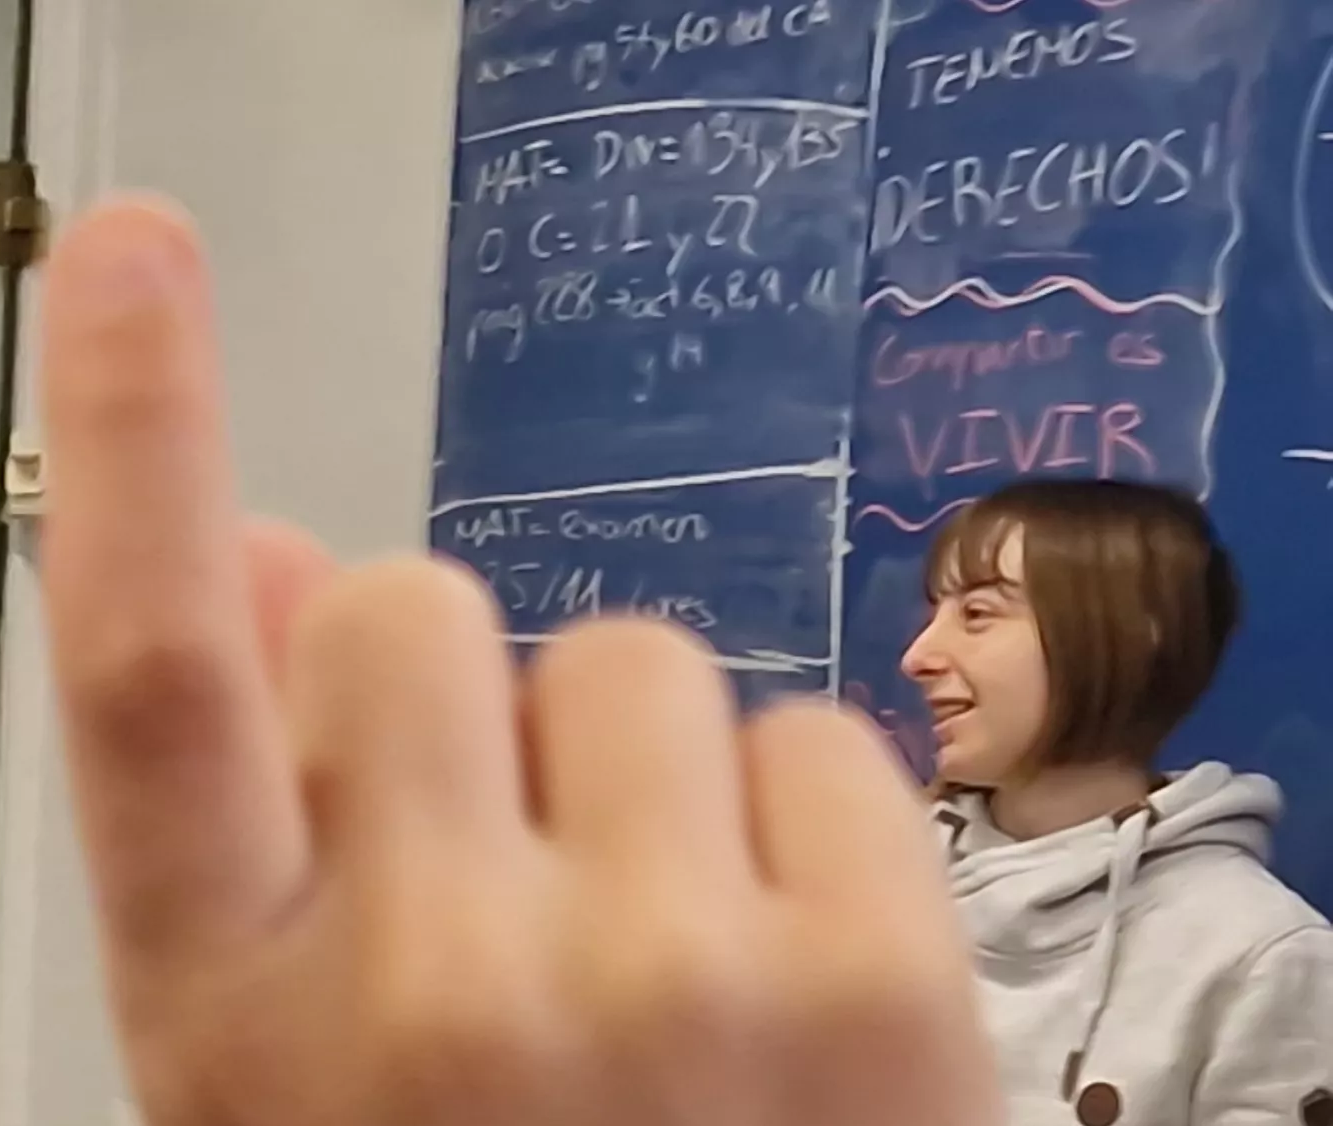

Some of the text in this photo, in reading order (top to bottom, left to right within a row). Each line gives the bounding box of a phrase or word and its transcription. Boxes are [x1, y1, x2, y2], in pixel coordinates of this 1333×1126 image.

[907, 18, 1137, 110] TENEMOS
[1108, 330, 1167, 366] es
[898, 402, 1158, 500] VIVIR
